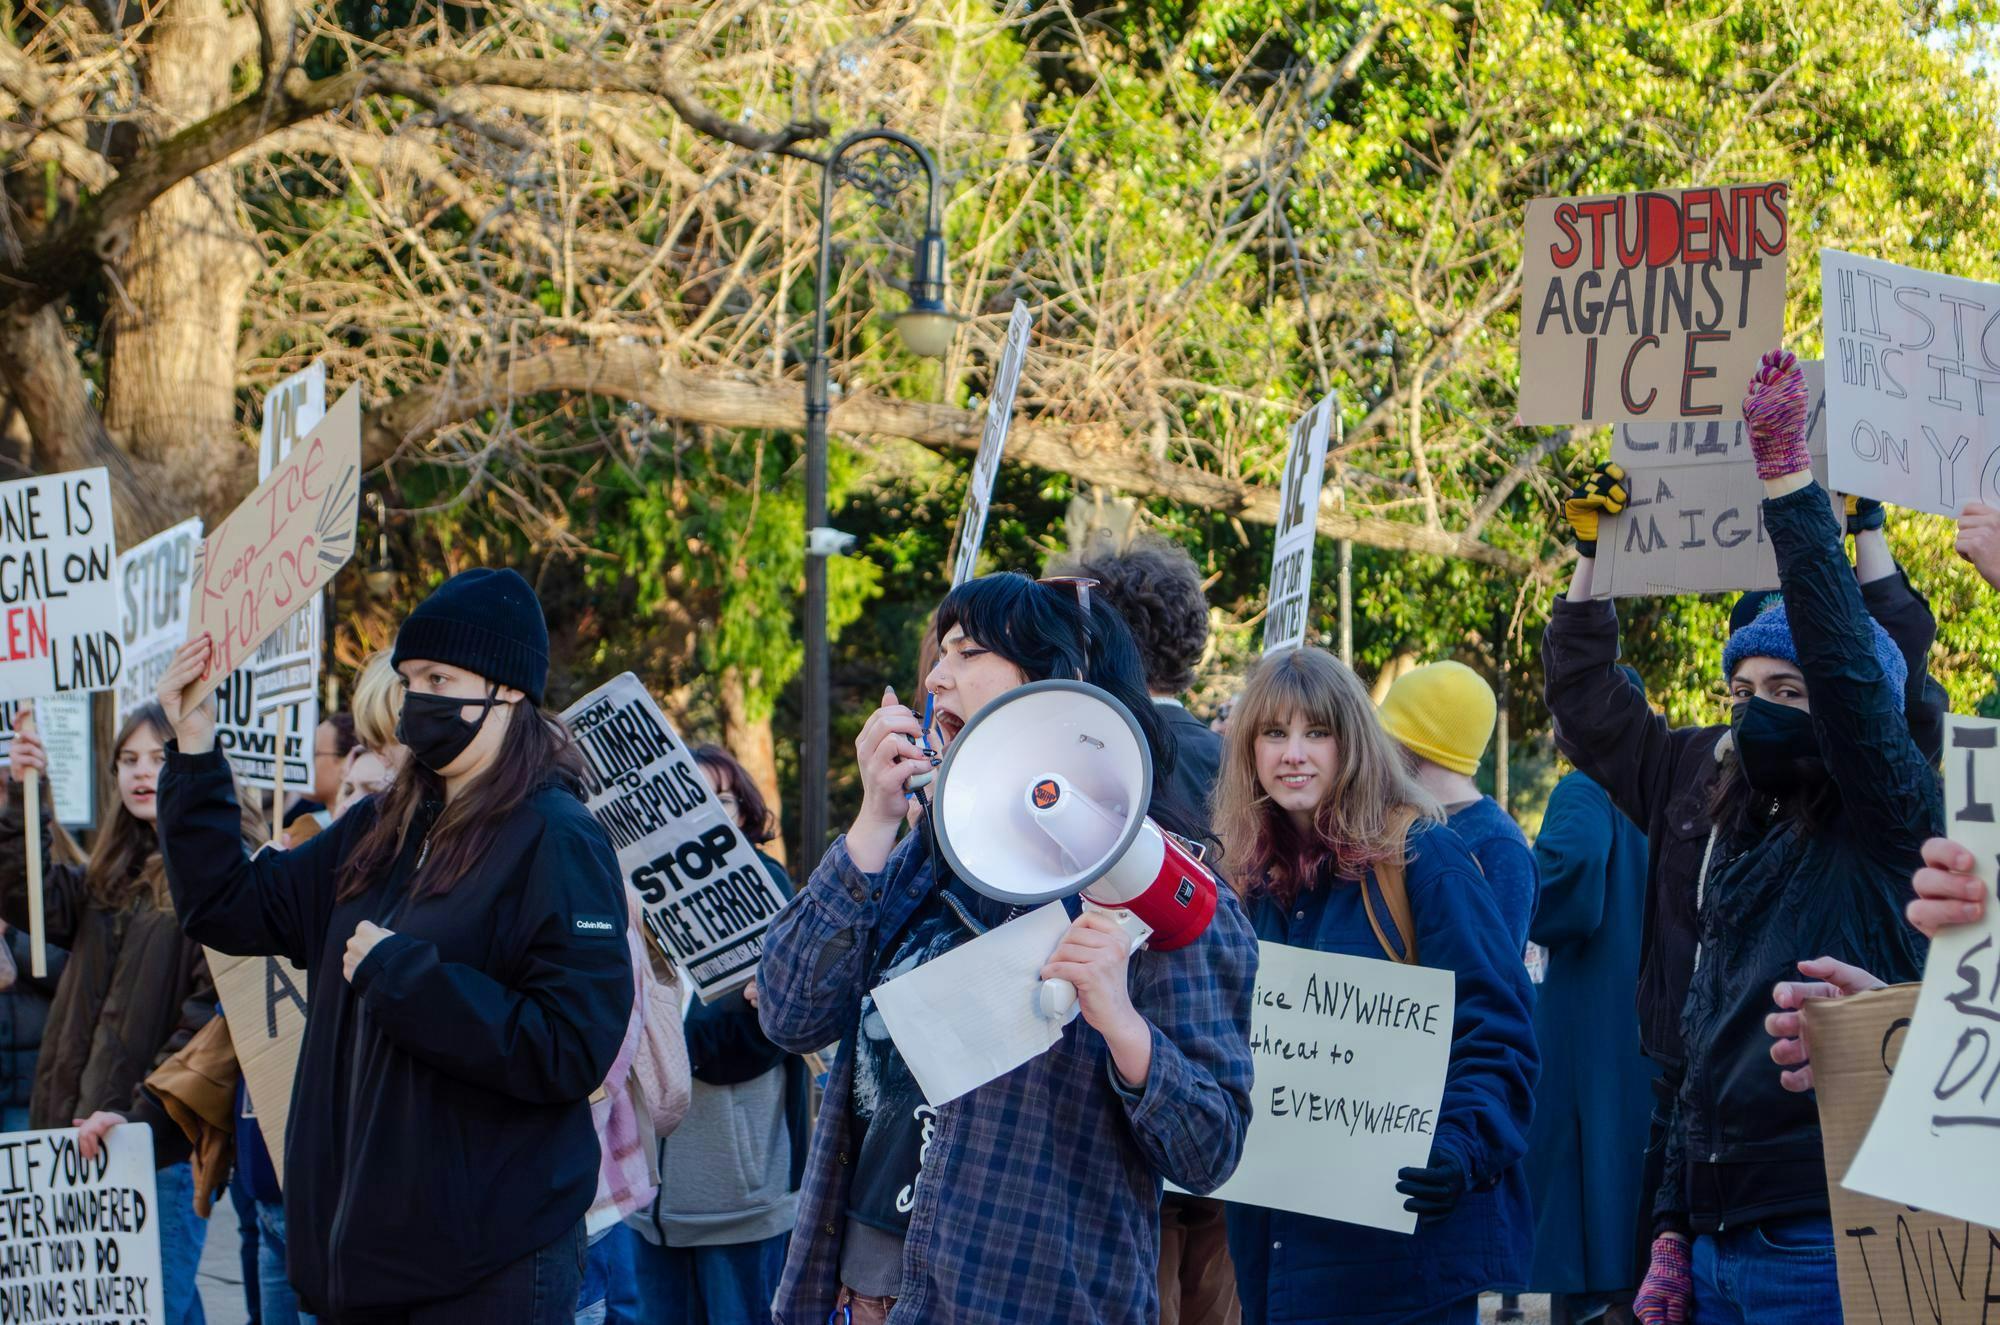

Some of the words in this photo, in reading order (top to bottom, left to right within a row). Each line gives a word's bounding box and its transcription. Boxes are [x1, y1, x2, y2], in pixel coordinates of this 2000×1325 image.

[1550, 183, 1787, 270] STUDENTS
[1536, 258, 1763, 337] AGAINST
[1581, 330, 1731, 420] ICE
[1839, 337, 1908, 399] HAS
[1851, 419, 1910, 474] ON
[0, 487, 48, 543] NE
[63, 480, 93, 536] IS
[0, 547, 68, 602] GAL
[123, 534, 190, 647] STOP
[0, 602, 48, 661] EN
[51, 631, 121, 692] LAND
[572, 700, 616, 738] FROM
[615, 771, 641, 793] TO
[632, 824, 737, 905] STOP
[576, 920, 597, 929] Calvin
[597, 921, 613, 930] Klein
[653, 902, 707, 960] ICE
[681, 864, 781, 944] TERROR
[1253, 985, 1292, 1010] ice
[1303, 973, 1440, 1035] ANYWHERE
[1251, 1023, 1318, 1060] threat
[1330, 1044, 1354, 1065] to
[0, 1139, 42, 1194] IF
[52, 1186, 146, 1235] WONDERED
[0, 1242, 42, 1280] WHAT
[95, 1237, 119, 1274] DO
[0, 1280, 66, 1325] DURING
[72, 1276, 148, 1316] SLAVERY
